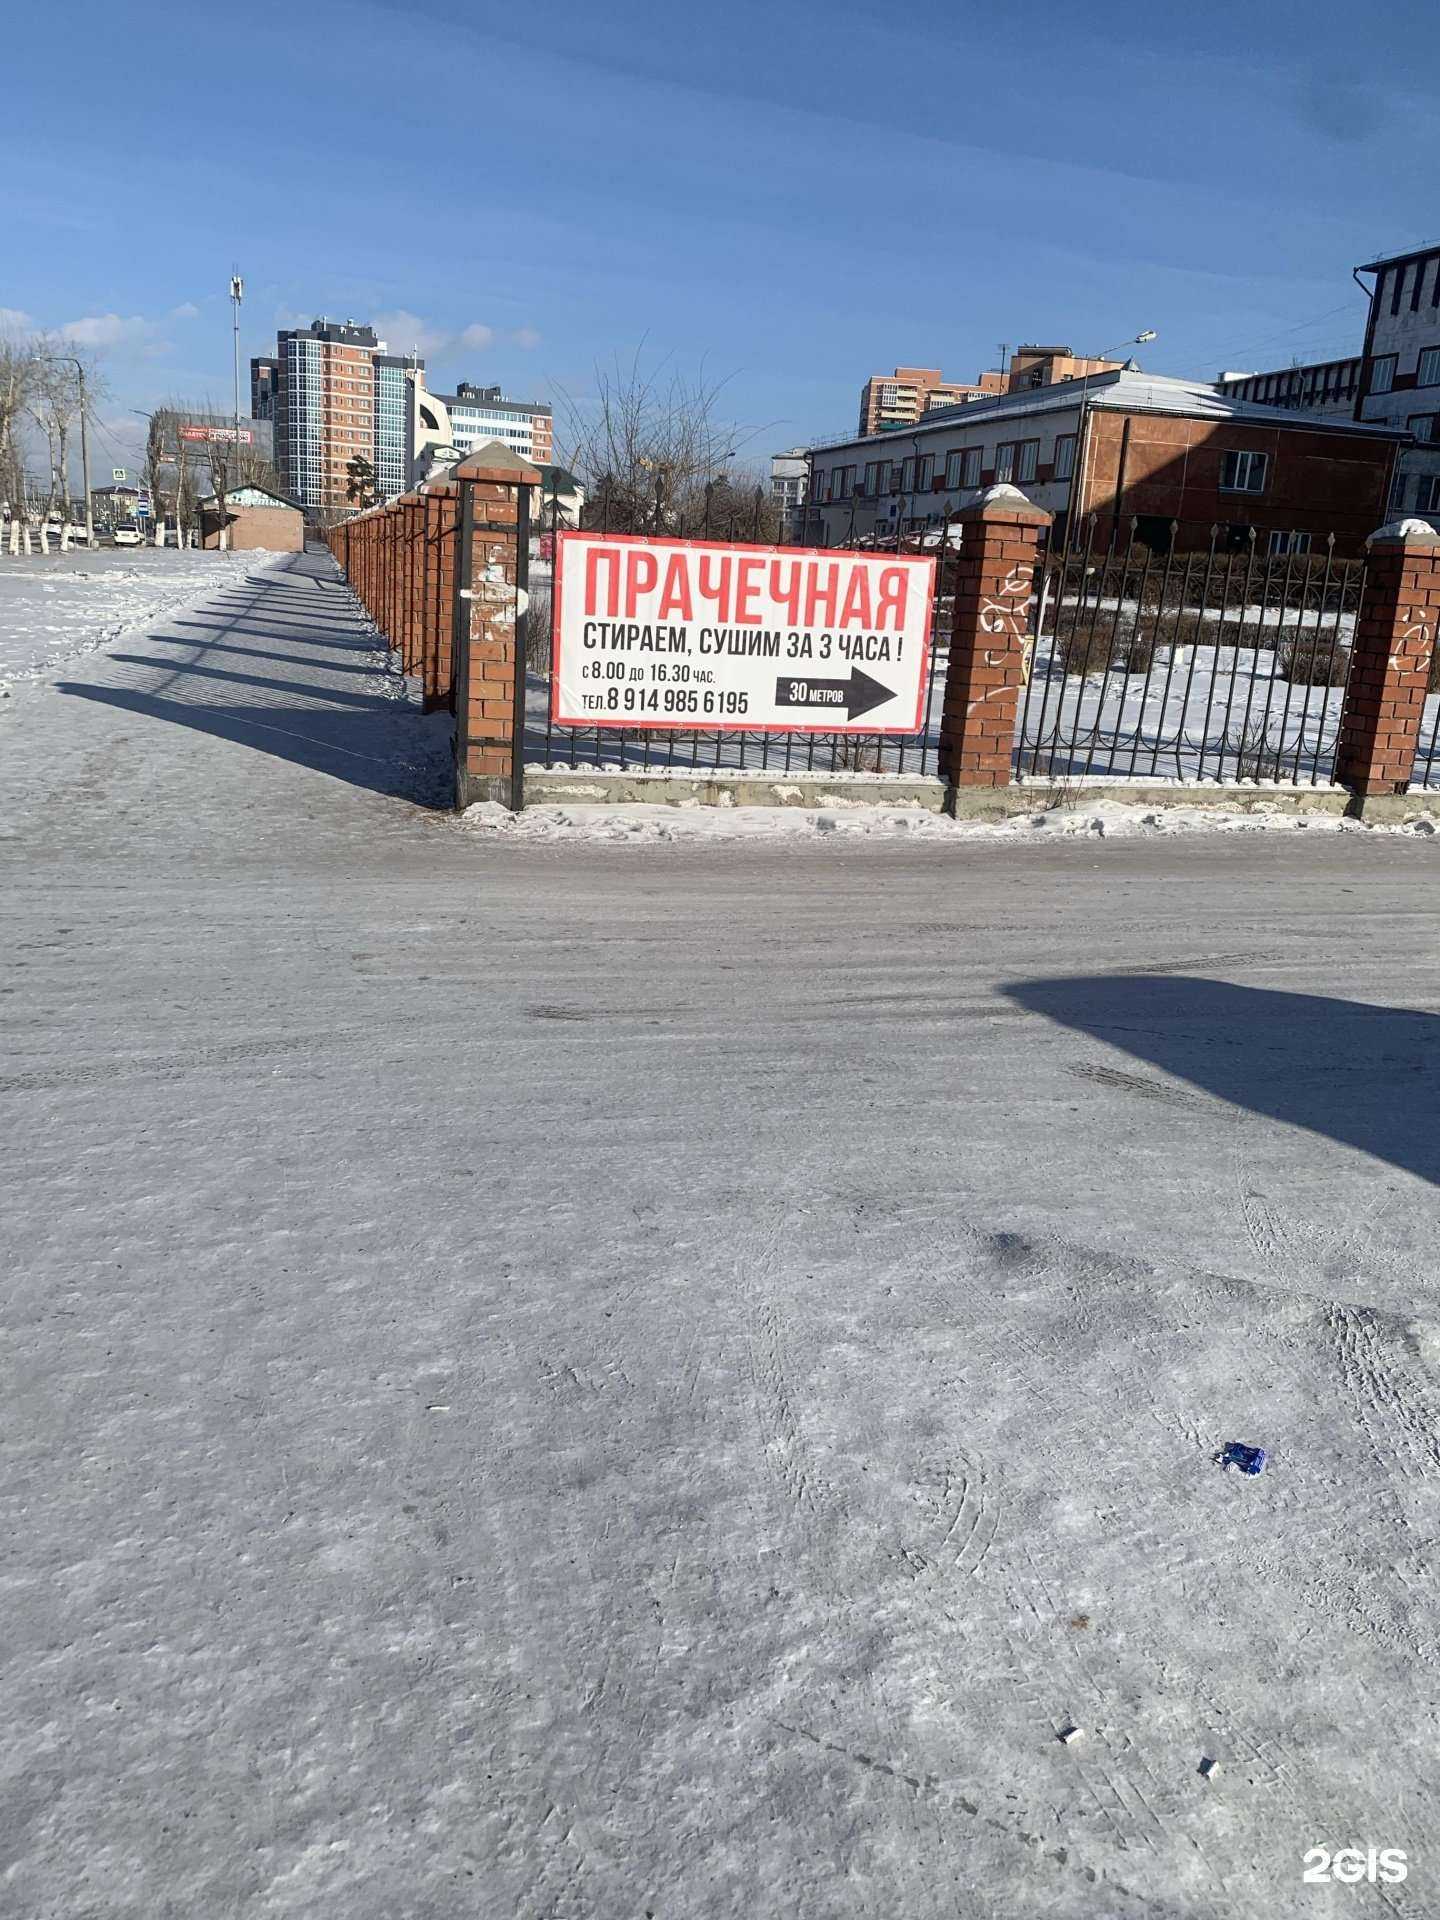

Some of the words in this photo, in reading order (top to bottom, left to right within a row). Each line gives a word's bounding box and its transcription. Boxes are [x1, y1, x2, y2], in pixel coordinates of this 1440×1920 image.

[584, 547, 910, 632] ПРАЧЕЧНАЯ
[583, 621, 693, 657] СТИРАЕМ,
[699, 627, 781, 657] СУШИМ
[786, 631, 813, 659] ЗА
[819, 633, 832, 659] 3
[838, 634, 891, 662] ЧАСА
[591, 660, 626, 680] 8.00
[650, 663, 691, 683] 16.30
[624, 687, 659, 712] 914
[664, 689, 698, 713] 985
[703, 690, 749, 715] 6195
[789, 682, 808, 702] 30
[808, 689, 844, 703] МЕТРОВ
